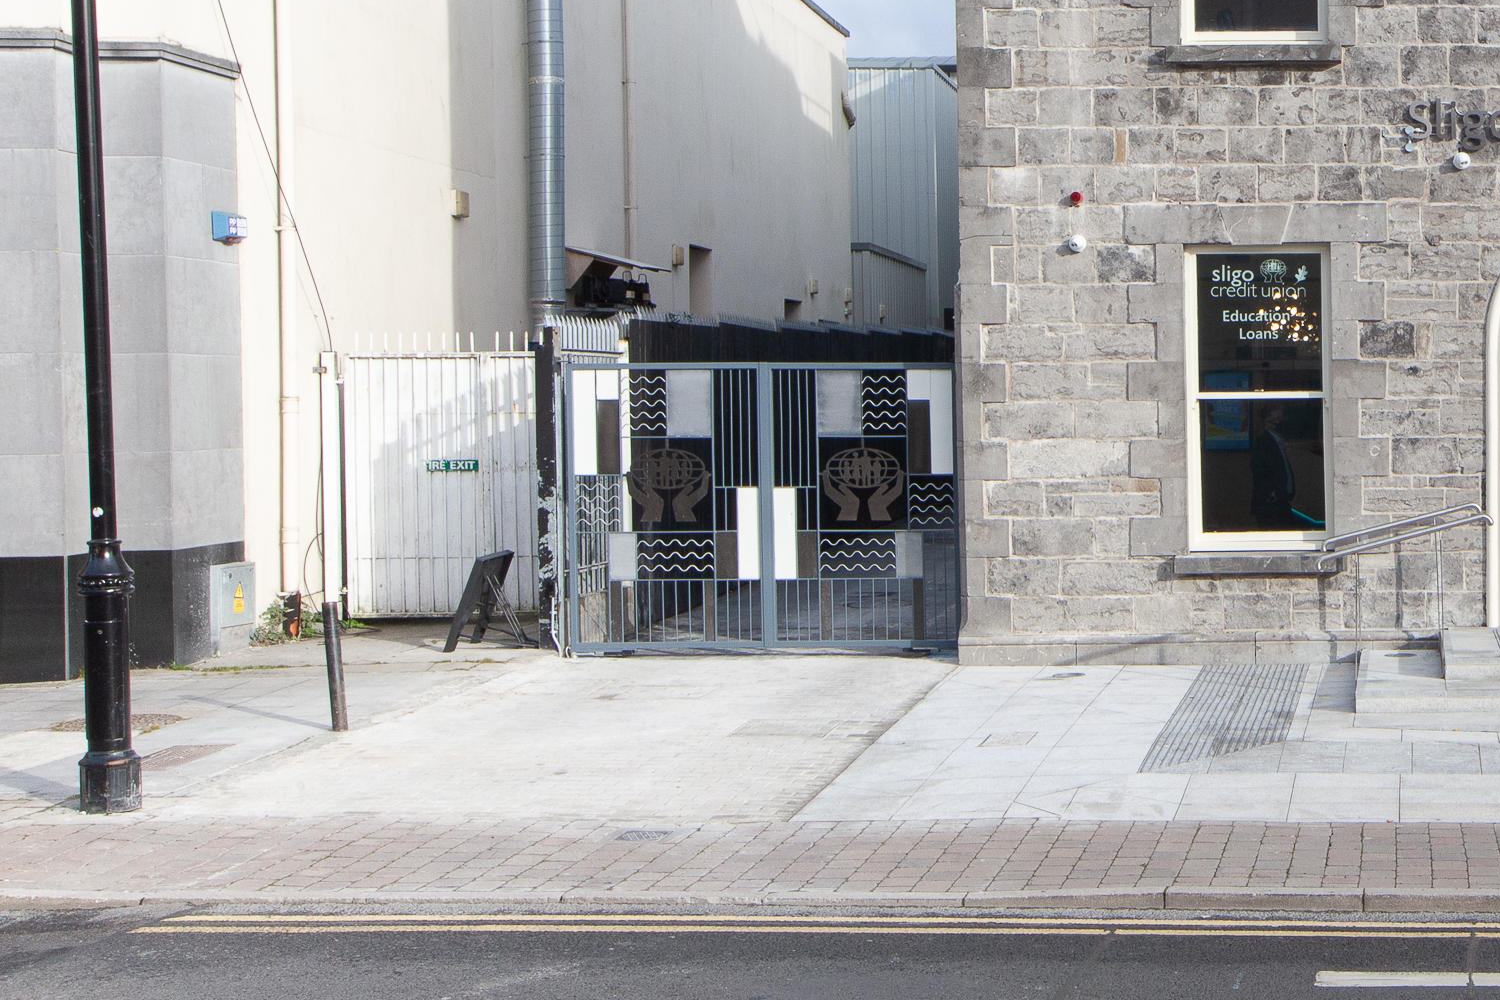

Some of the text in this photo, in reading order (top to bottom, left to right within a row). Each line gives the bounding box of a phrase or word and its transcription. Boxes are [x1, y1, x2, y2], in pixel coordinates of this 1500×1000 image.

[1211, 264, 1254, 287] sligo
[1210, 282, 1307, 298] credit union
[1222, 309, 1291, 322] Education
[1239, 328, 1279, 340] Loans
[428, 460, 476, 470] IRE EXIT
